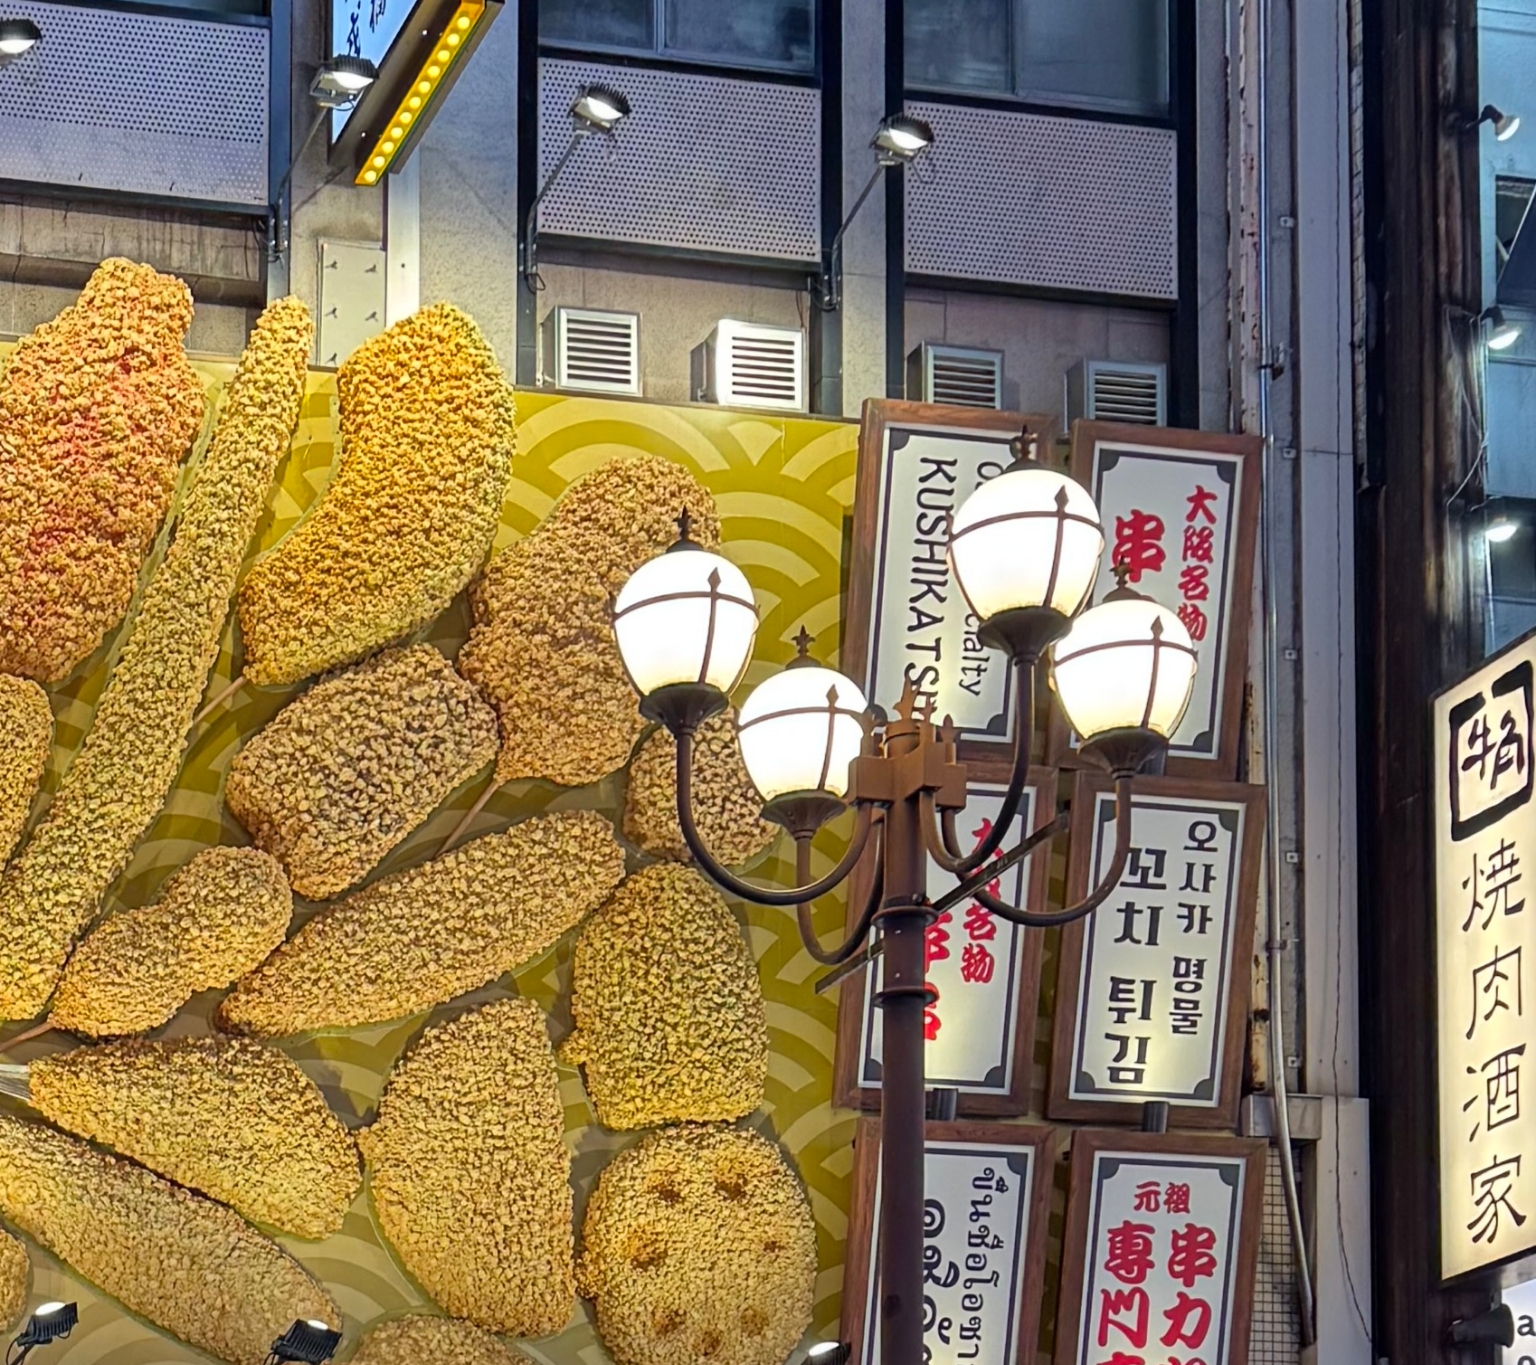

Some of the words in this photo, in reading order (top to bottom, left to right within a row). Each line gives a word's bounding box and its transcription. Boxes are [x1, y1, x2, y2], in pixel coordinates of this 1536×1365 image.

[1177, 484, 1220, 643] 大阪名物
[1114, 846, 1167, 946] 꼬치
[1178, 820, 1217, 935] 오사카
[1104, 975, 1157, 1085] 튀김
[1168, 956, 1207, 1035] 명물
[1463, 838, 1526, 1244] 焼肉酒家
[1134, 1180, 1192, 1216] 元祖
